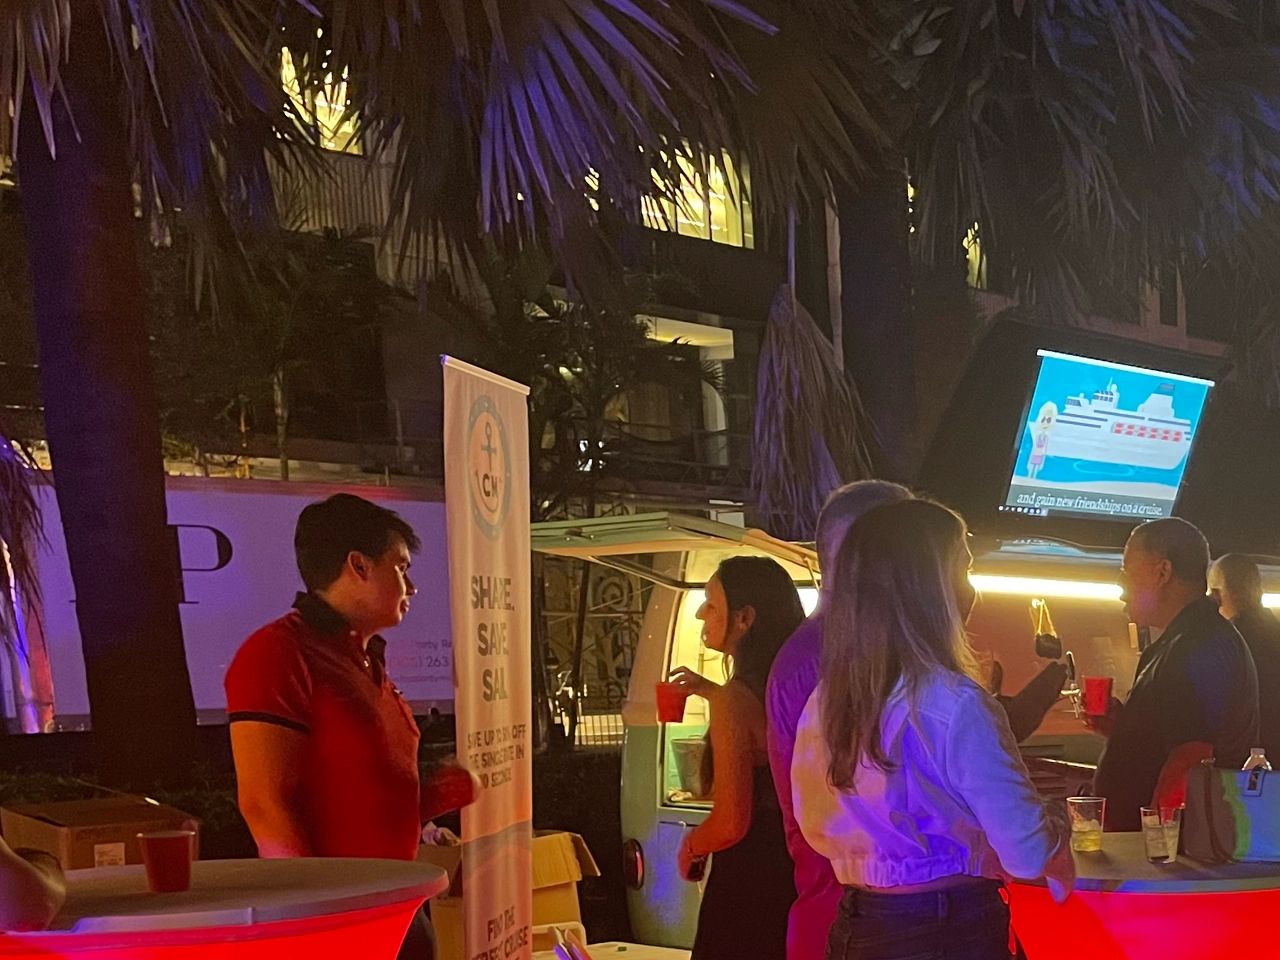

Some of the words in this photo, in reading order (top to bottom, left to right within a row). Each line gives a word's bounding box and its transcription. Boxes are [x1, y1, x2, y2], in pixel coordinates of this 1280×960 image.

[1017, 493, 1035, 504] and
[1035, 494, 1055, 508] gain
[1056, 497, 1072, 507] new
[1074, 496, 1121, 514] friendships
[1121, 503, 1132, 513] on
[426, 655, 449, 668] 263
